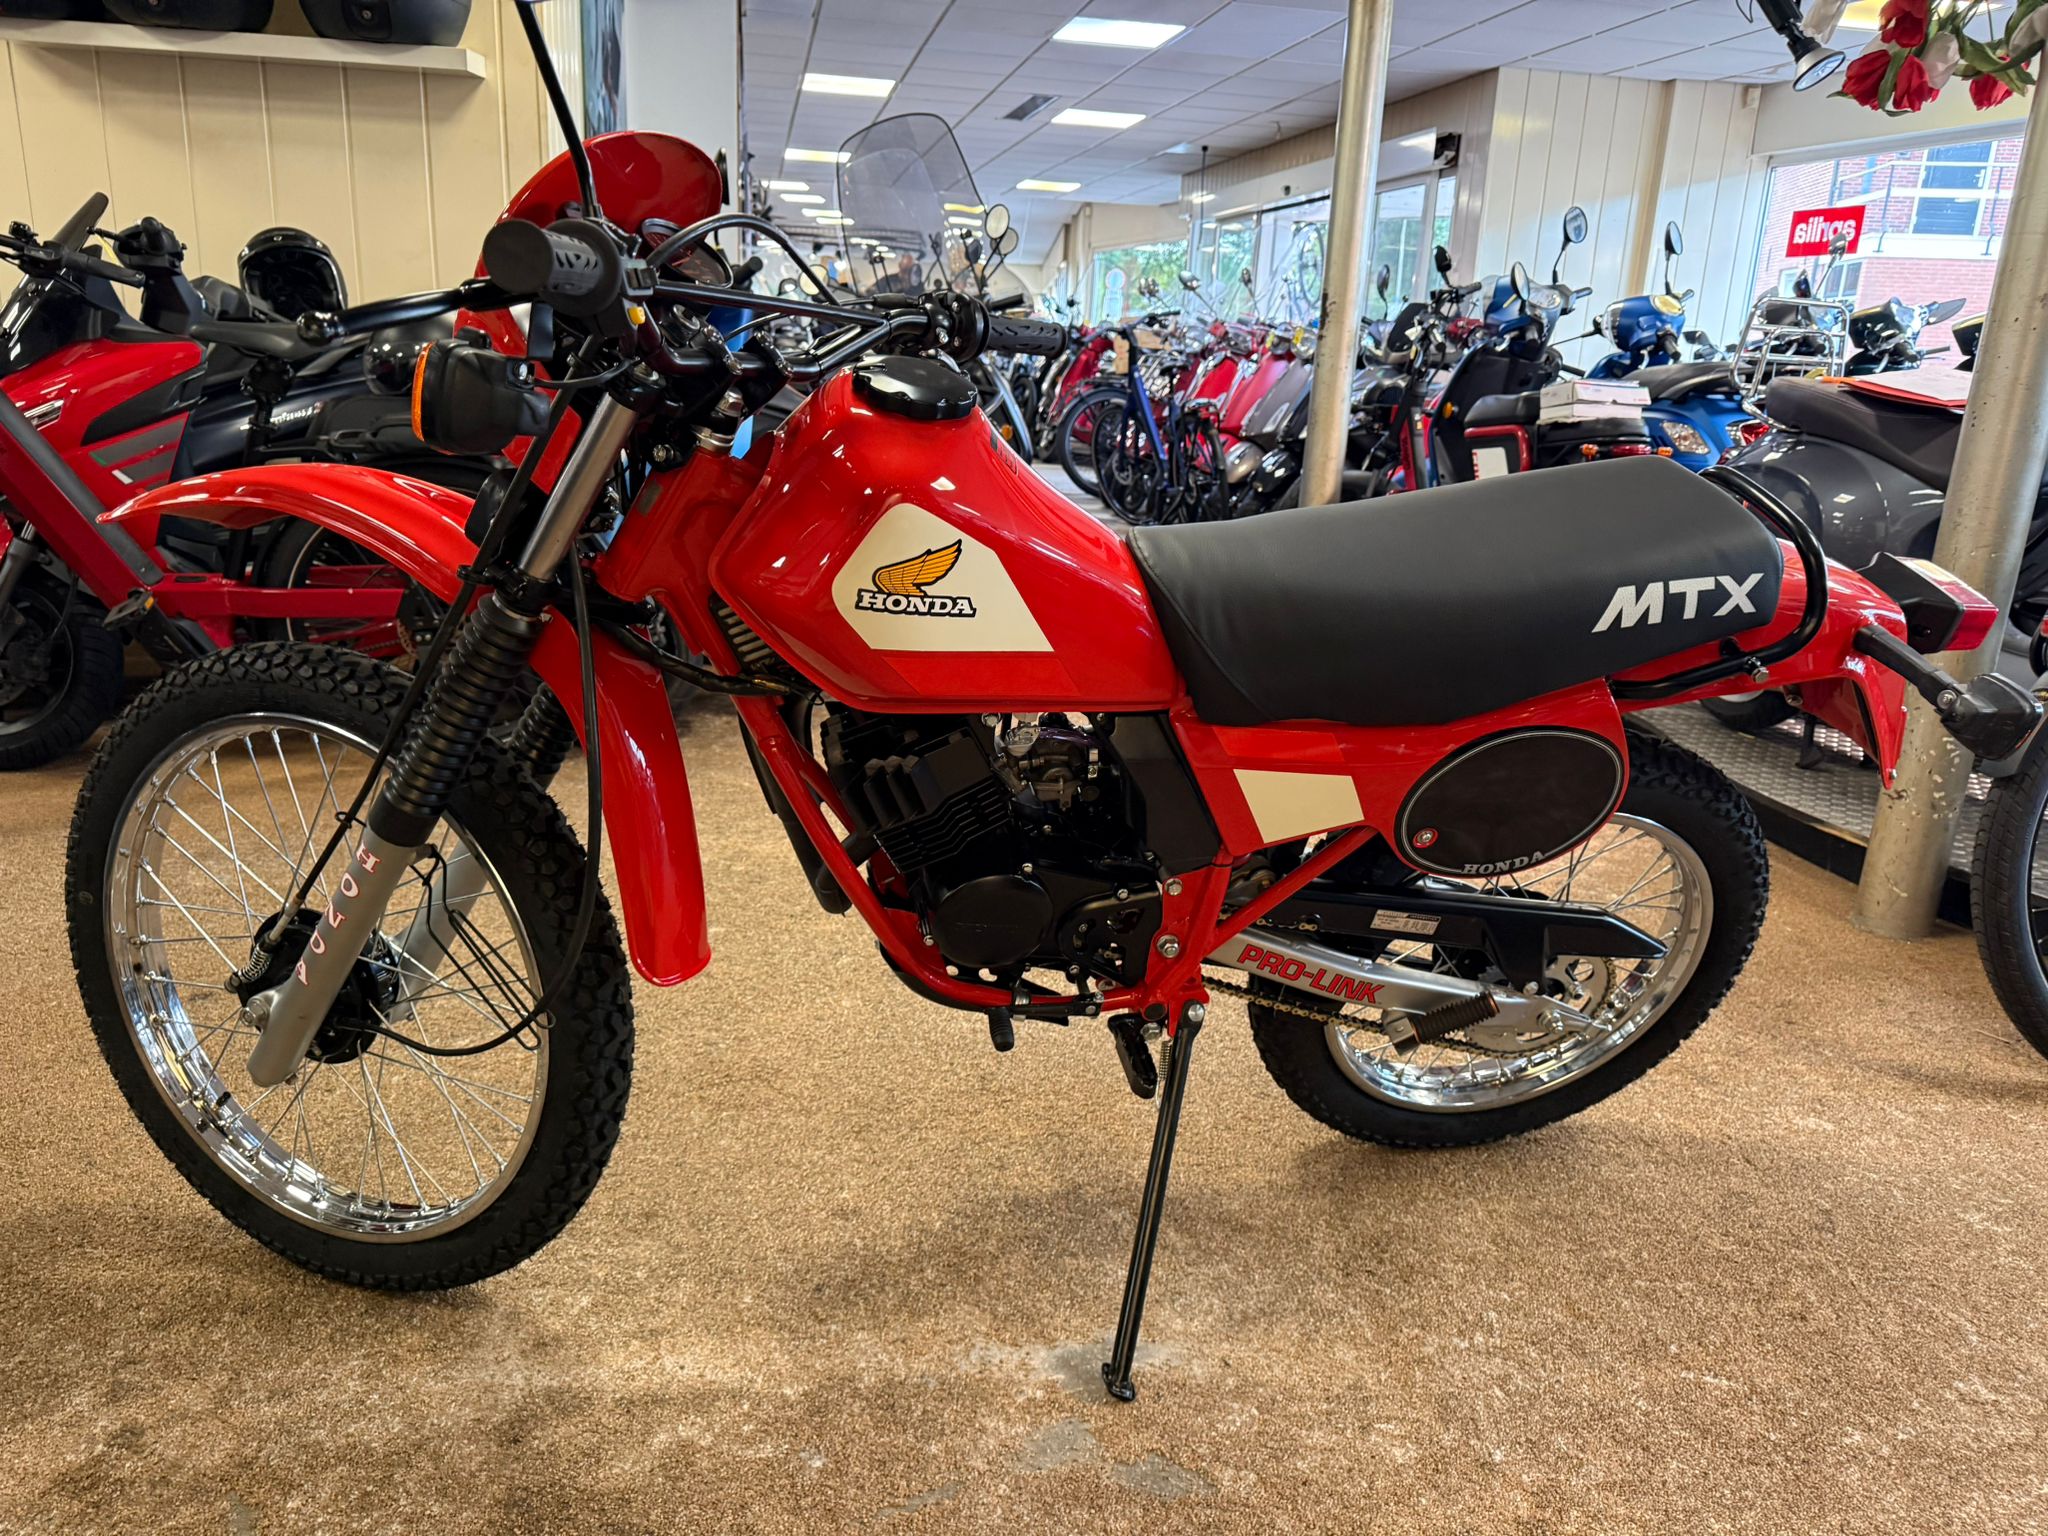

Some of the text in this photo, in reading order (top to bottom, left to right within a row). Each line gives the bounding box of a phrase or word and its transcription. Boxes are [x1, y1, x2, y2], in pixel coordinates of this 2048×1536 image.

[857, 590, 975, 615] HONDA
[1591, 572, 1765, 634] MTX
[1460, 850, 1546, 875] HONDA
[295, 840, 382, 986] HONDA
[1236, 943, 1385, 1004] PRO-LINK
